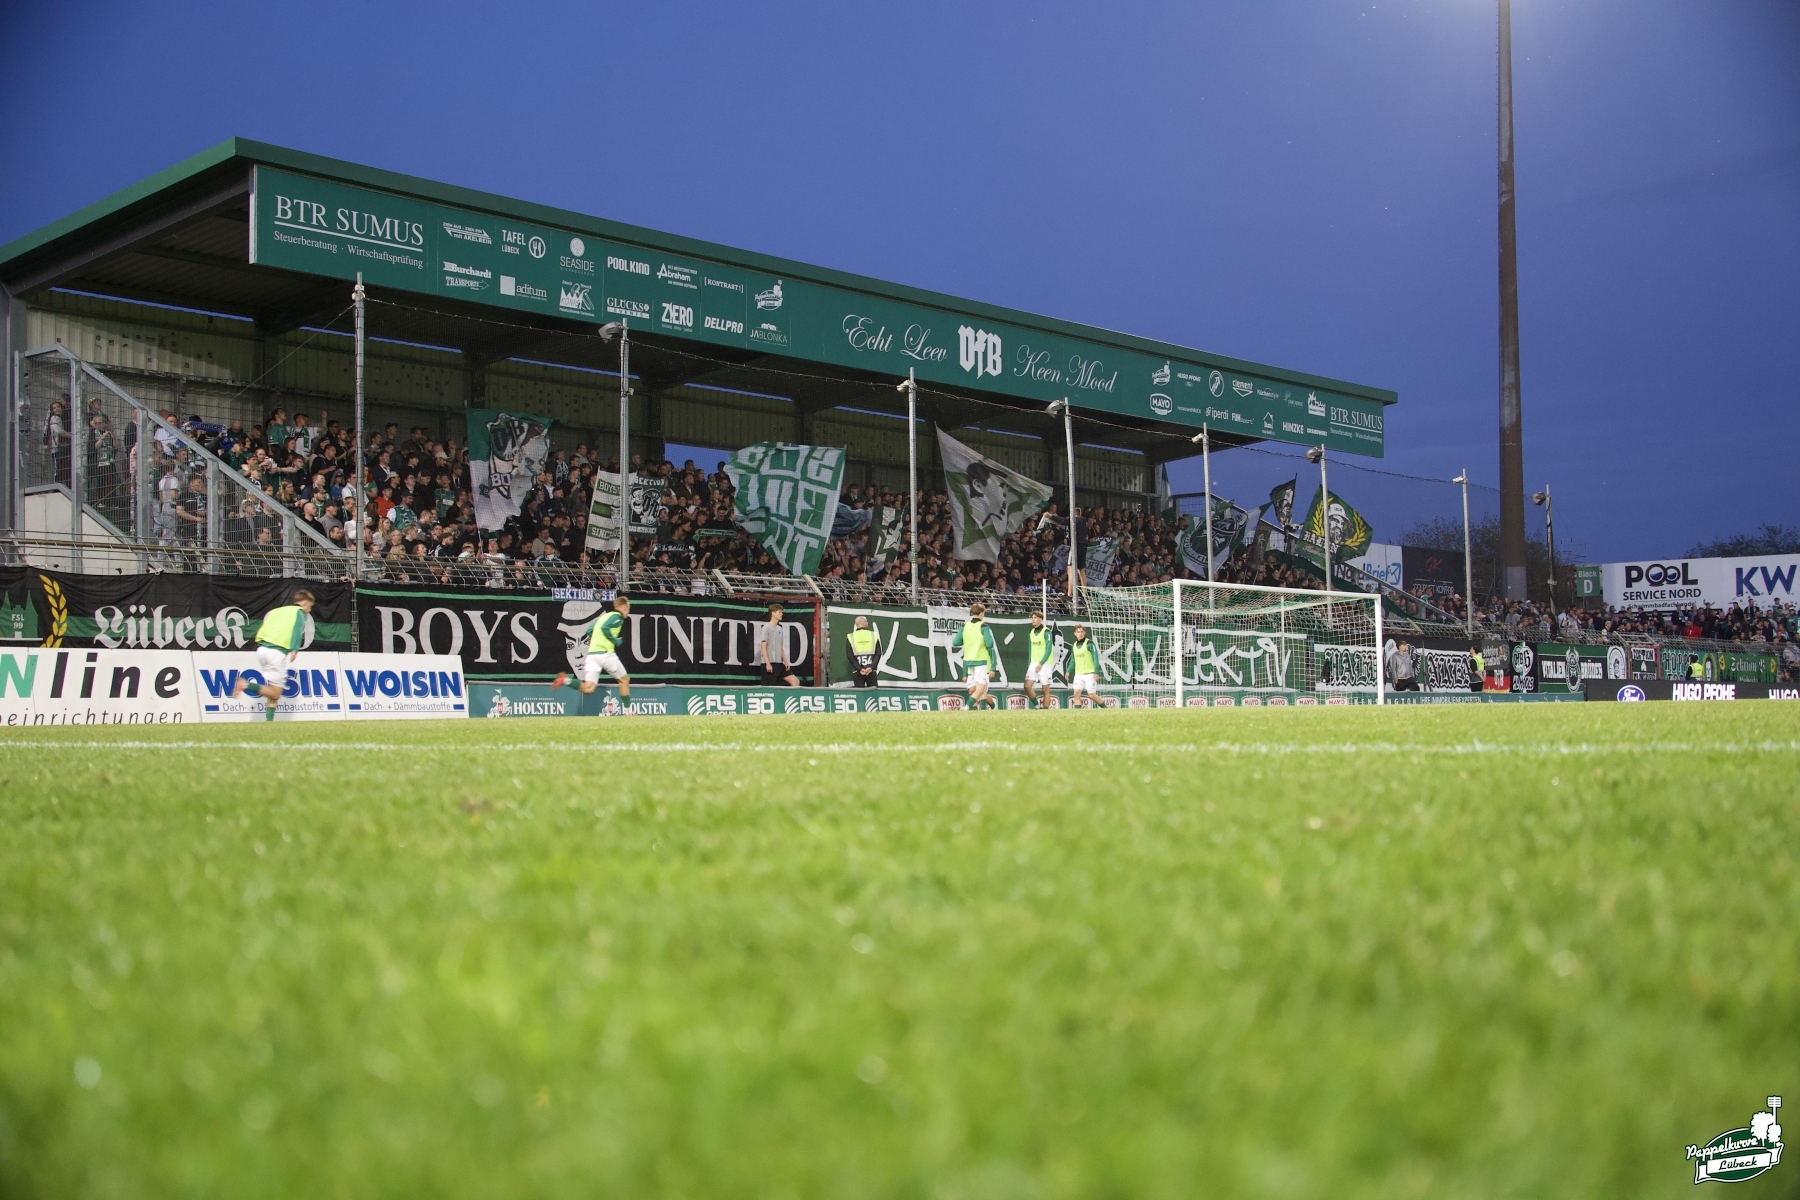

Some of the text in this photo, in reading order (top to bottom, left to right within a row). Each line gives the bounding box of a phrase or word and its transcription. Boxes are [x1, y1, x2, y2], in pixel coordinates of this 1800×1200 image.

[275, 195, 424, 246] BTR SUMUS
[502, 229, 526, 245] TAFEL
[274, 231, 423, 269] Steuerberatung Wirtschaftsprüfung
[501, 244, 520, 254] LÜBECK
[451, 262, 492, 279] Burchardt
[560, 255, 594, 273] SEASIDE
[656, 262, 691, 282] Abraham
[516, 283, 547, 298] aditum
[704, 316, 744, 334] DELLPRO
[749, 329, 788, 344] JABLONKA
[842, 314, 893, 352] Echt
[900, 323, 948, 363] Leev
[1013, 344, 1063, 384] Keen
[1065, 354, 1118, 393] Mood
[1152, 398, 1171, 409] MAYO
[1211, 407, 1229, 420] iperdi
[1330, 406, 1382, 430] BTR SUMUS
[1578, 570, 1597, 578] Block
[1624, 562, 1699, 589] POOL
[554, 588, 594, 600] SEKTION
[1584, 579, 1593, 594] D
[1622, 588, 1702, 601] SERVICE NORD
[11, 613, 25, 621] FSL
[13, 621, 24, 630] 99
[375, 605, 540, 664] BOYS
[199, 668, 340, 699] WOSIN
[344, 669, 464, 698] WOISIN
[1672, 683, 1736, 701] HUGO PFOHE
[1768, 688, 1799, 700] HUGO
[222, 702, 248, 712] Dach-
[257, 701, 325, 713] Dämbaustoffe
[364, 702, 386, 711] Dach-
[394, 701, 451, 712] Dämmbaustoffe
[513, 701, 566, 715] HOLSTEN
[706, 694, 737, 711] FLS
[747, 697, 775, 715] 30
[799, 695, 826, 712] FLS
[834, 698, 858, 713] 30
[878, 696, 902, 711] FLS
[908, 699, 931, 713] 30
[942, 699, 961, 707] MAYO
[1010, 699, 1026, 707] MAYO
[0, 706, 183, 727] einrichtungen
